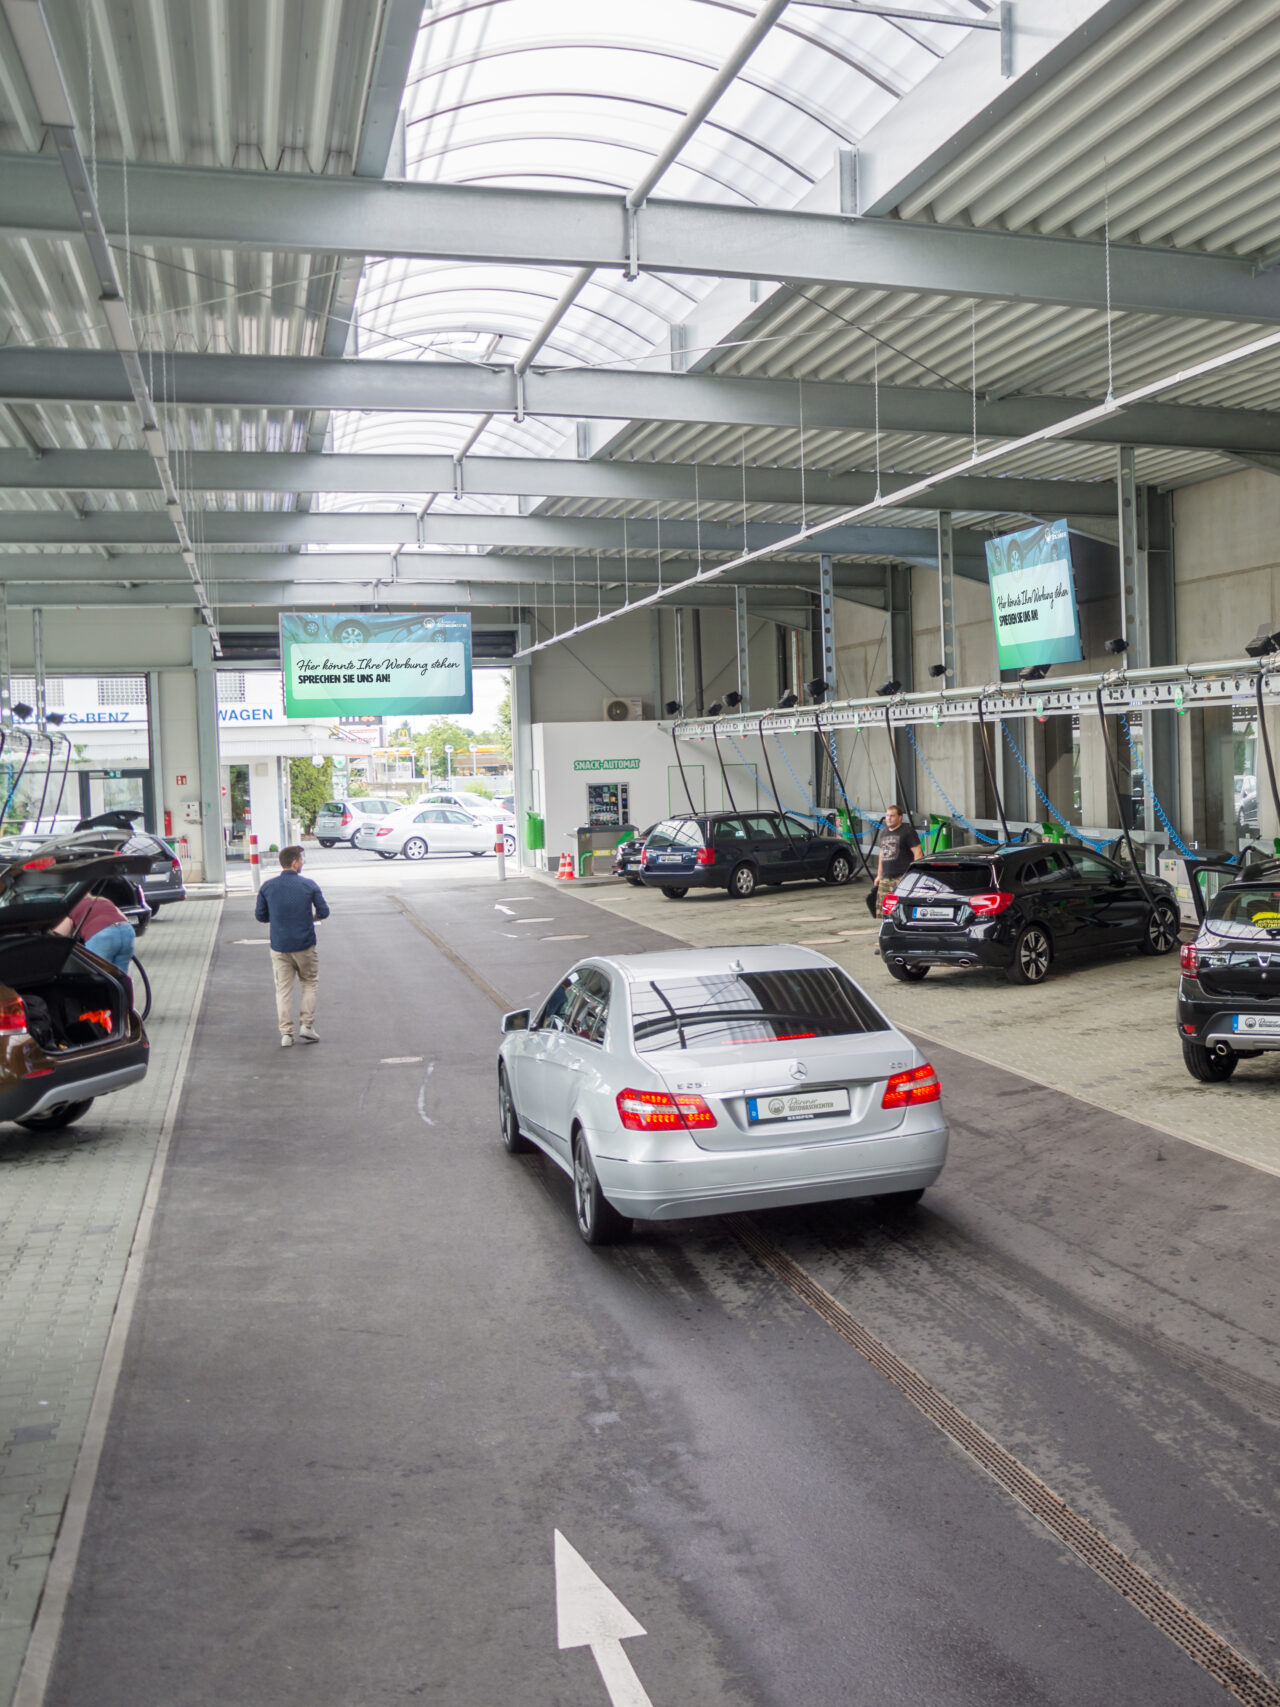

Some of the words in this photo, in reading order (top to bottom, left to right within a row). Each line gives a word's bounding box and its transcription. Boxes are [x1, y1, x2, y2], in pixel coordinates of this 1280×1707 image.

[296, 659, 320, 672] Hier
[322, 658, 355, 671] könnte
[356, 658, 381, 671] Ihre
[382, 658, 428, 676] Werbung
[430, 657, 460, 669] stehen
[298, 674, 341, 684] SPRECHEN
[342, 674, 355, 683] SIE
[357, 674, 374, 683] UNS
[376, 674, 391, 683] AN!
[574, 759, 640, 770] SNACK-AUTOMAT
